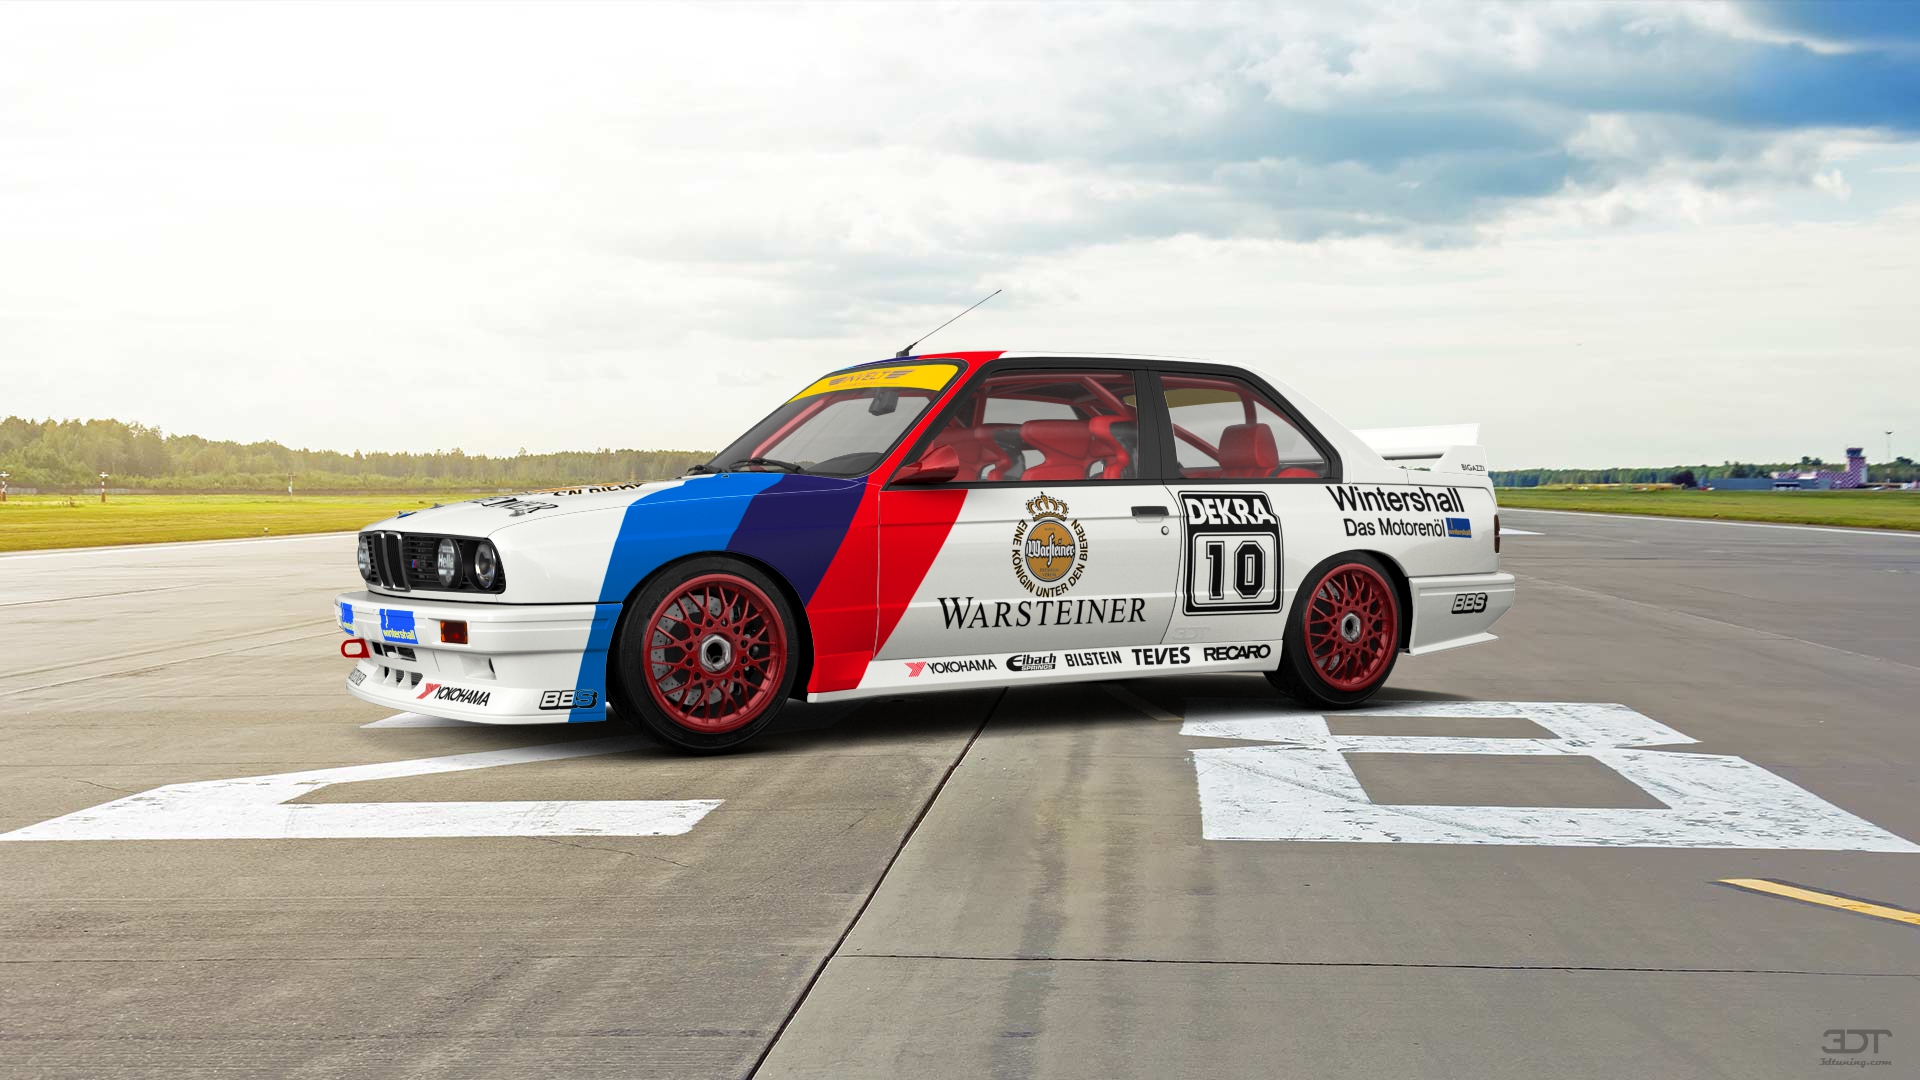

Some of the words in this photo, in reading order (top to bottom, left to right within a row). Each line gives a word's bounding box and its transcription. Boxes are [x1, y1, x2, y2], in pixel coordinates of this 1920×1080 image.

[1461, 463, 1486, 472] BIGAZZI
[1325, 485, 1465, 513] Wintershall
[1184, 498, 1277, 525] DEKRA
[1012, 519, 1028, 547] EINE
[1343, 517, 1376, 537] Das
[1378, 517, 1447, 538] Motorenöl
[1070, 518, 1089, 562] BIEREN
[438, 554, 454, 568] Hella
[1011, 549, 1036, 594] KÖNIGIN
[1205, 539, 1267, 601] 10
[1068, 563, 1086, 587] DEN
[1035, 582, 1069, 599] UNTER
[937, 596, 1147, 630] WARSTEINER
[1451, 592, 1488, 615] BBS
[1006, 652, 1057, 672] Eibach
[1064, 650, 1123, 668] BILSTEIN
[1131, 646, 1192, 666] TEVES
[1203, 643, 1273, 662] RECARO
[926, 658, 998, 675] YOKOHAMA
[434, 683, 491, 706] YOKOHAMA
[538, 689, 598, 710] BBS
